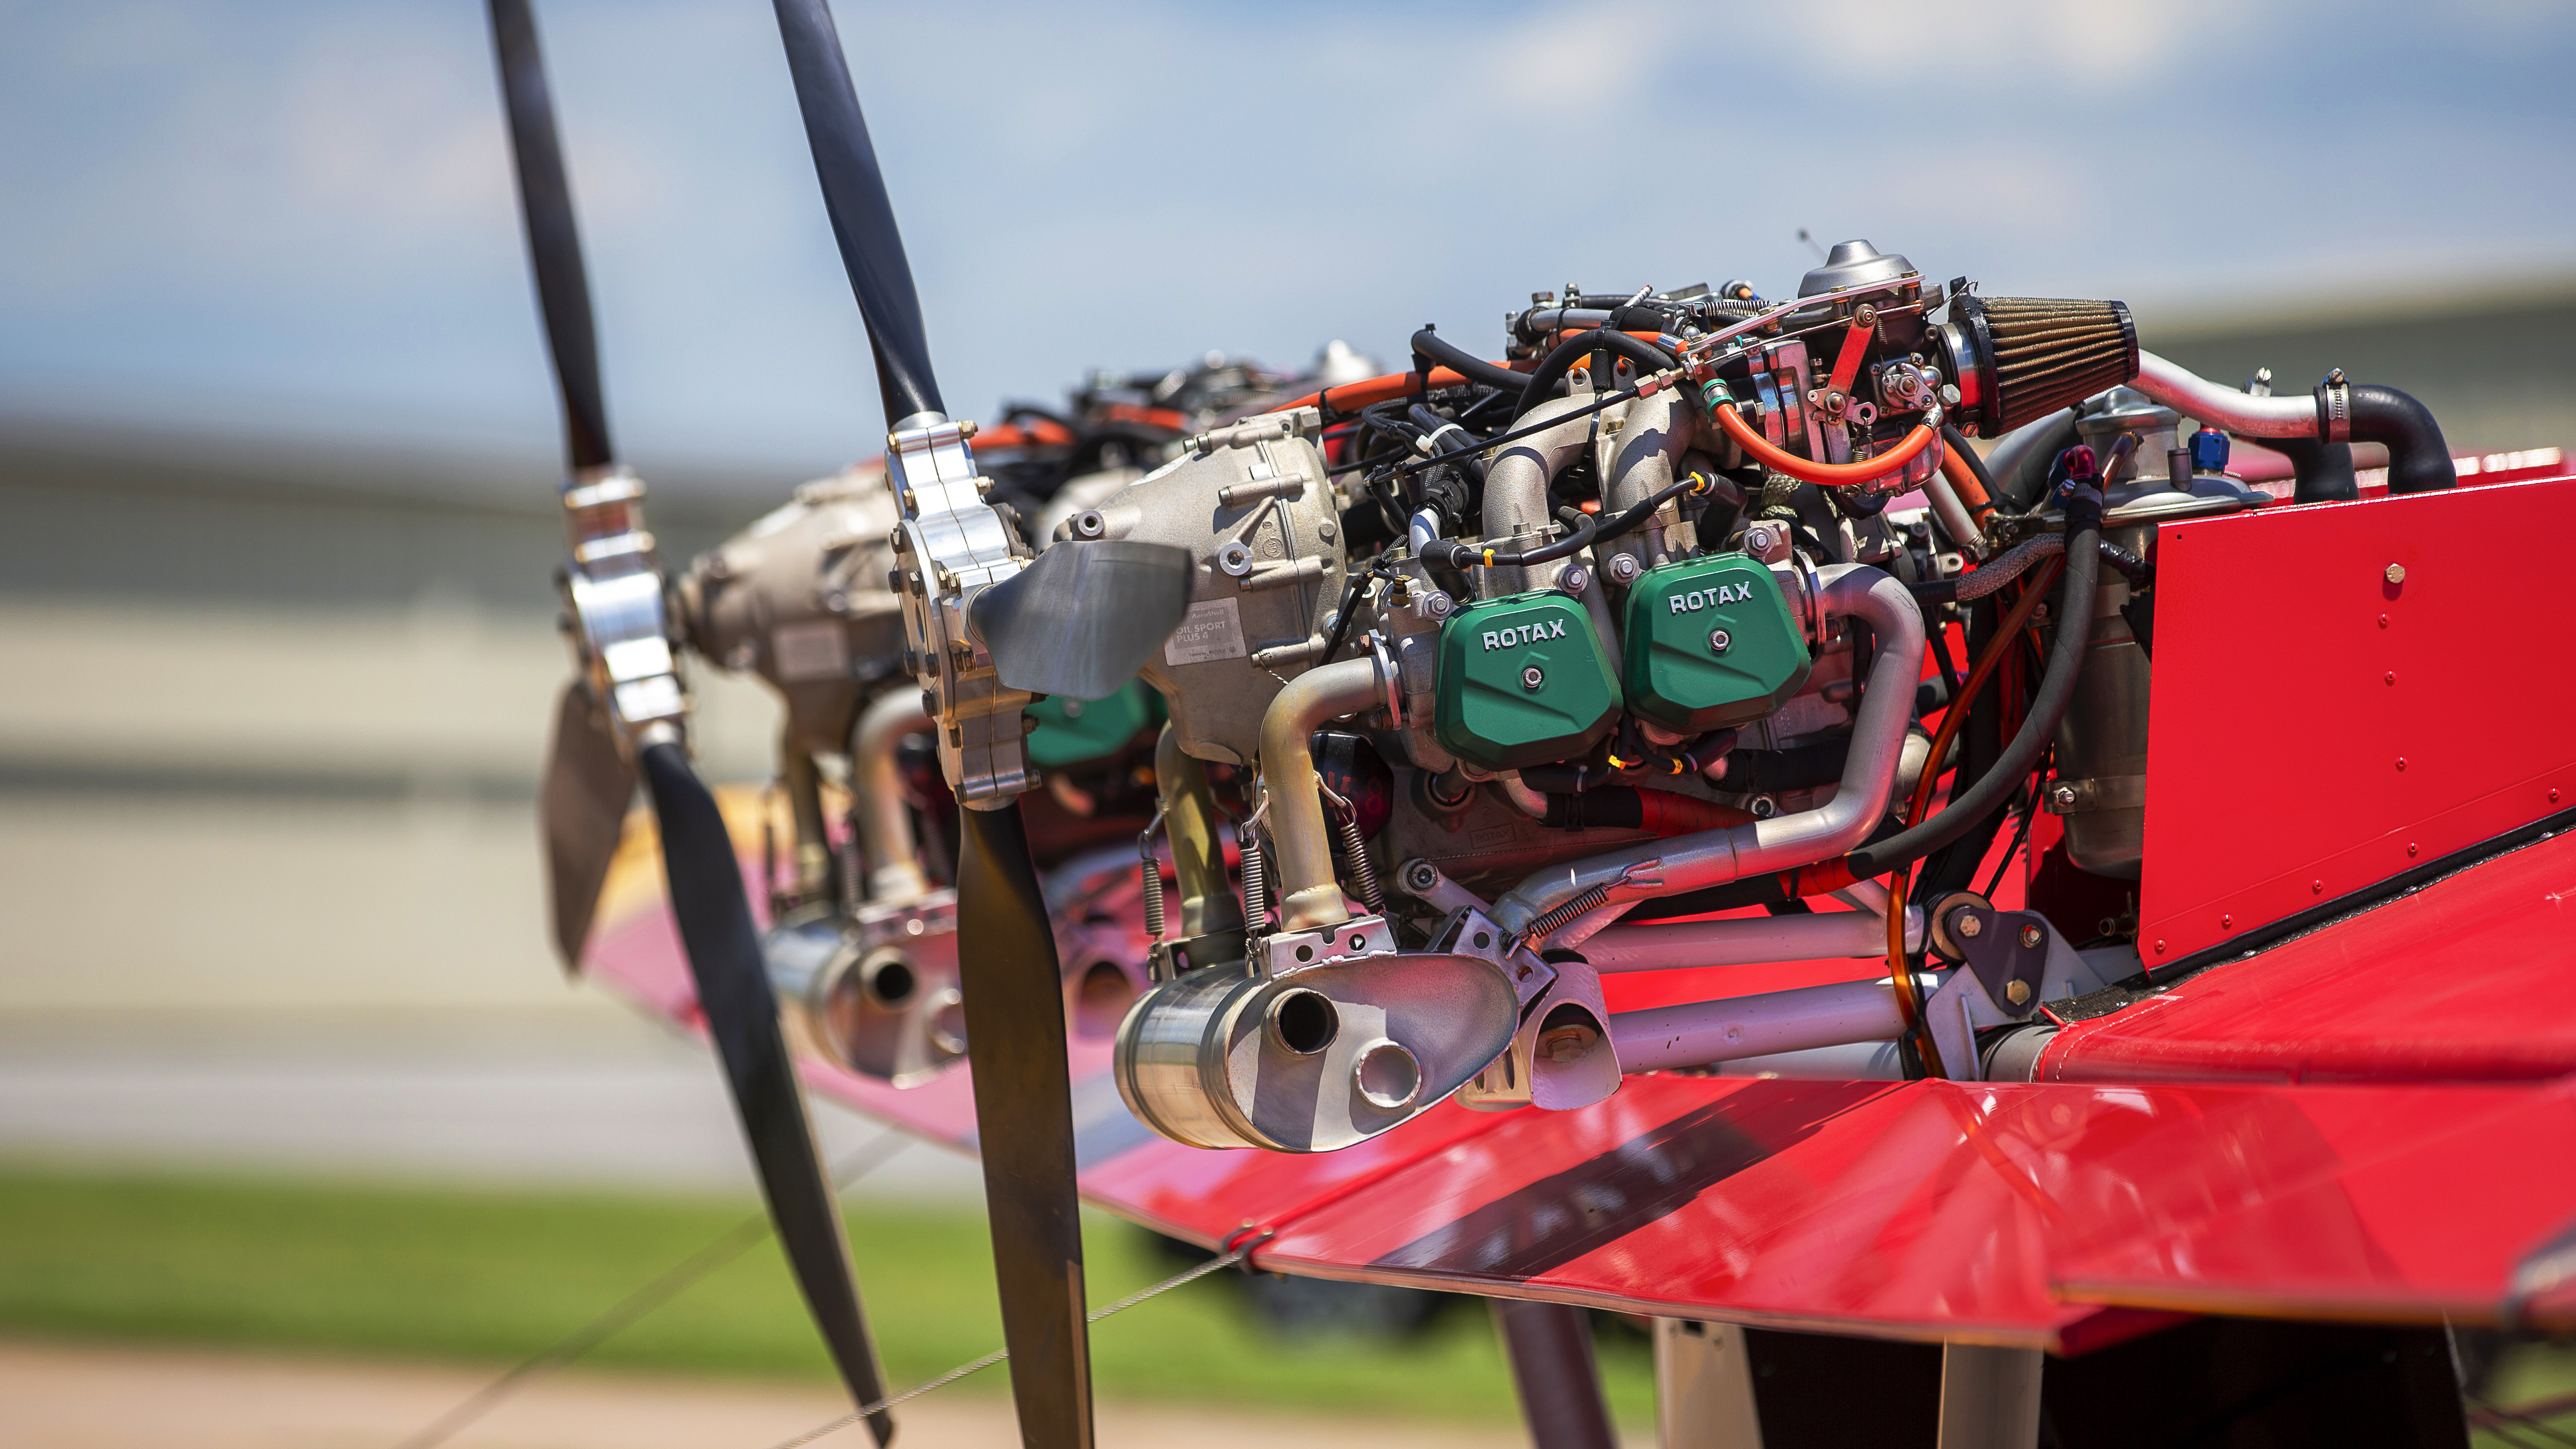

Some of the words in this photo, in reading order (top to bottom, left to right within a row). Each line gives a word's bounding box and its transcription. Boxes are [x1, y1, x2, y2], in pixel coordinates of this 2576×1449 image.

[1669, 581, 1753, 613] ROTAX
[1192, 609, 1224, 619] AeroShell
[1176, 626, 1192, 635] OIL
[1194, 621, 1225, 633] SPORT
[1482, 619, 1566, 650] ROTAX
[1177, 633, 1200, 643] PLUS
